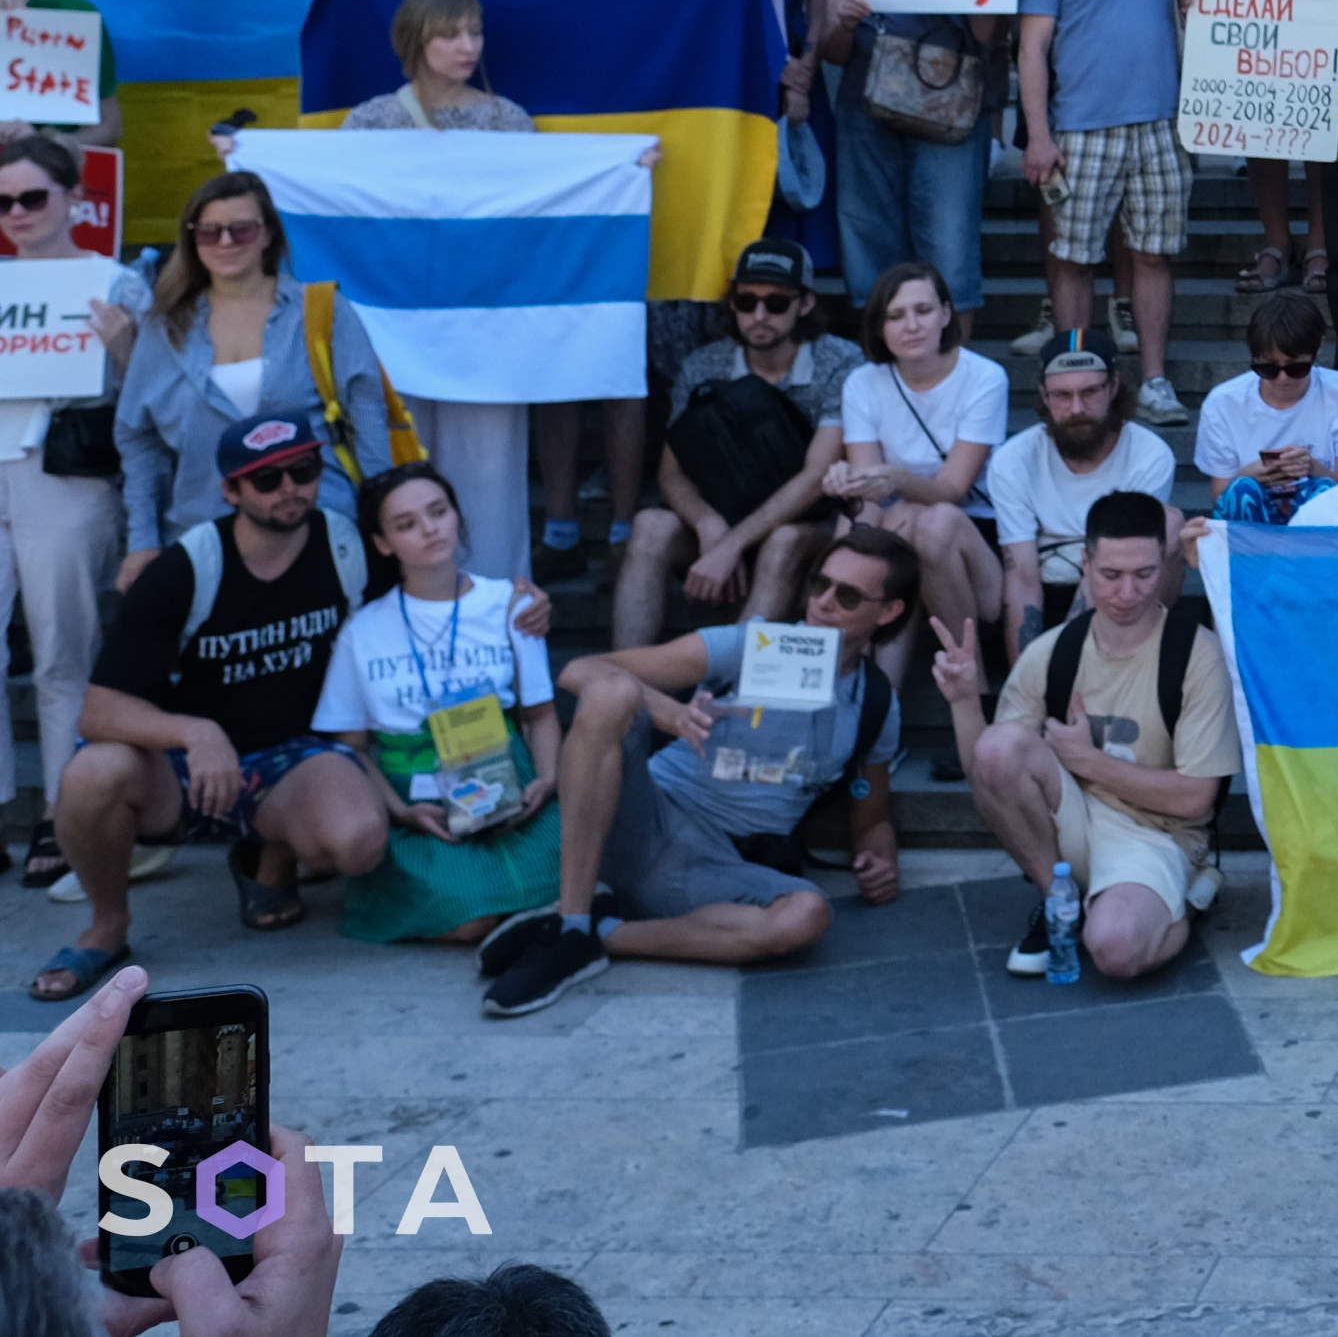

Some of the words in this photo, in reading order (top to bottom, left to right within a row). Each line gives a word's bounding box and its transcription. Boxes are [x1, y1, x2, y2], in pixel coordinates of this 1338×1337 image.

[1237, 47, 1338, 82] ВЫБОР!
[198, 621, 286, 660] ПУТИН
[290, 606, 338, 636] ИДИ
[779, 634, 826, 646] CHOOSE
[779, 645, 793, 655] TO
[796, 646, 826, 656] HELP
[222, 662, 256, 685] НА
[260, 641, 314, 676] ХУЙ
